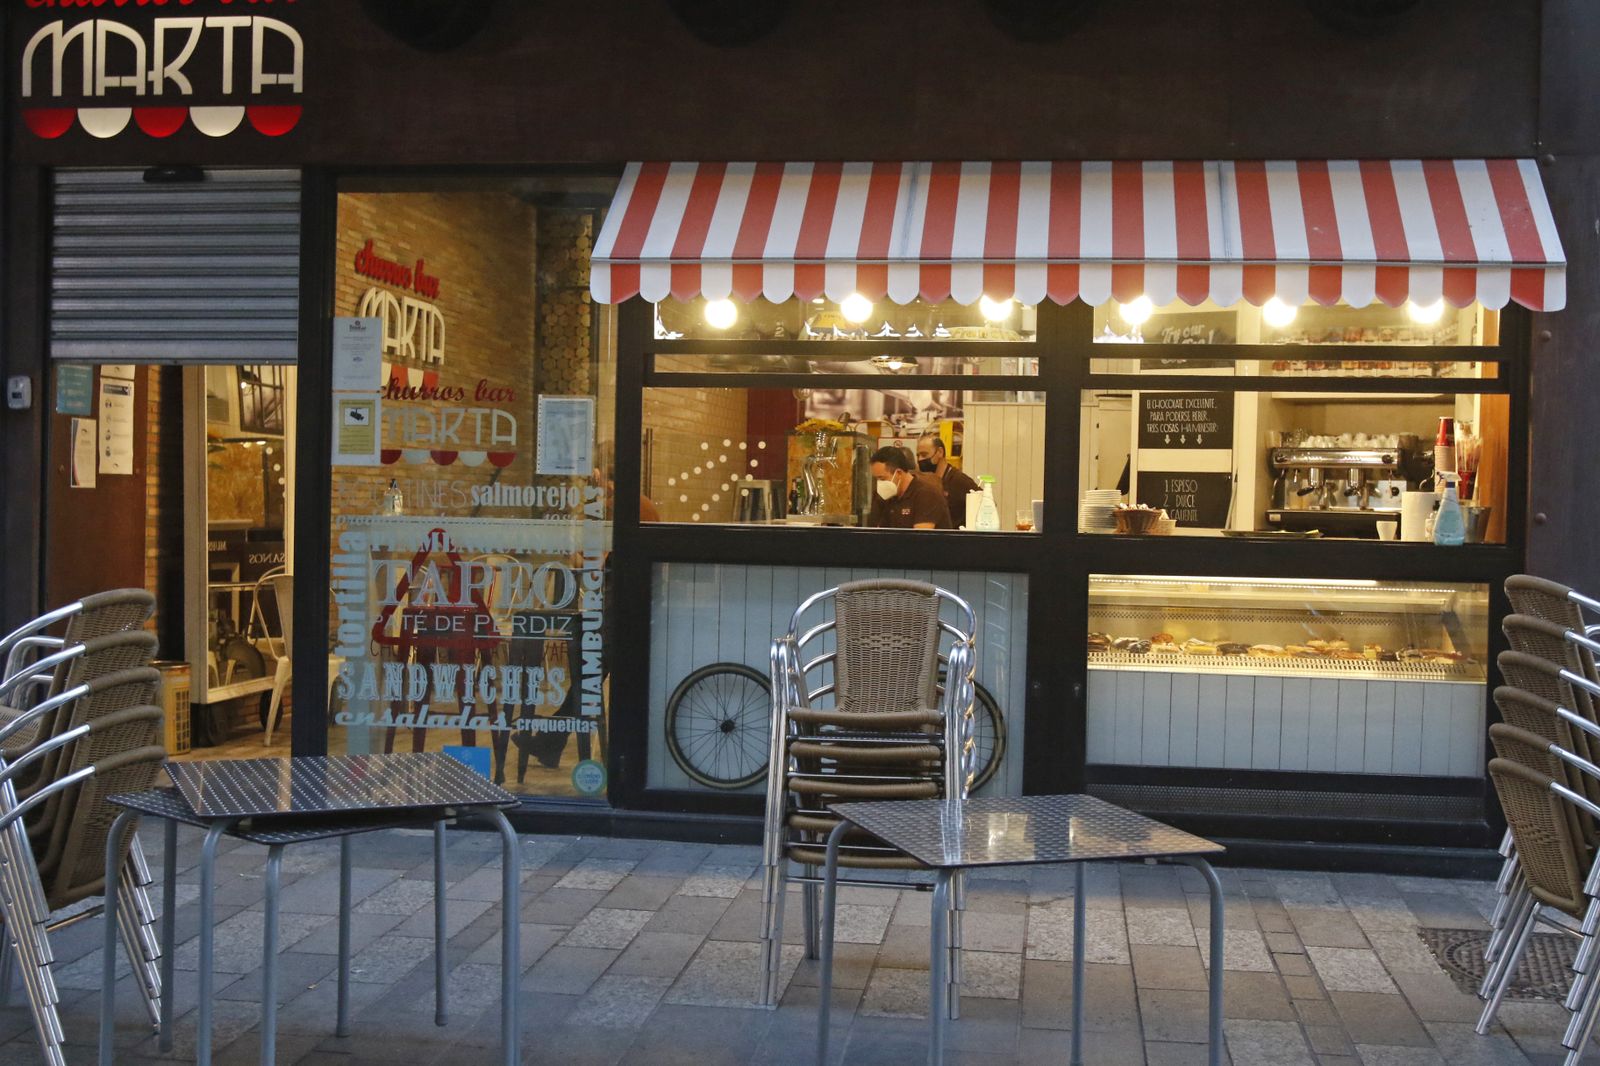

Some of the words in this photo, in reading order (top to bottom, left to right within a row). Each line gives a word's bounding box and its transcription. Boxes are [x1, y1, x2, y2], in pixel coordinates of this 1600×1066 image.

[21, 15, 304, 97] MARTA
[360, 286, 446, 365] MARTA
[379, 376, 465, 401] churros
[475, 378, 517, 402] bar
[382, 407, 517, 446] MARTA
[1160, 423, 1180, 433] COSAS
[471, 481, 580, 510] salmorejo
[1163, 494, 1169, 507] 2
[332, 531, 369, 657] tortilla
[371, 558, 577, 609] TAPEO
[374, 610, 427, 632] PATÉ
[435, 615, 466, 632] DE
[474, 614, 573, 636] PERDIZ
[337, 661, 567, 706] SANDWICHES
[334, 703, 512, 732] ensaladas
[515, 716, 599, 734] croquetitas
